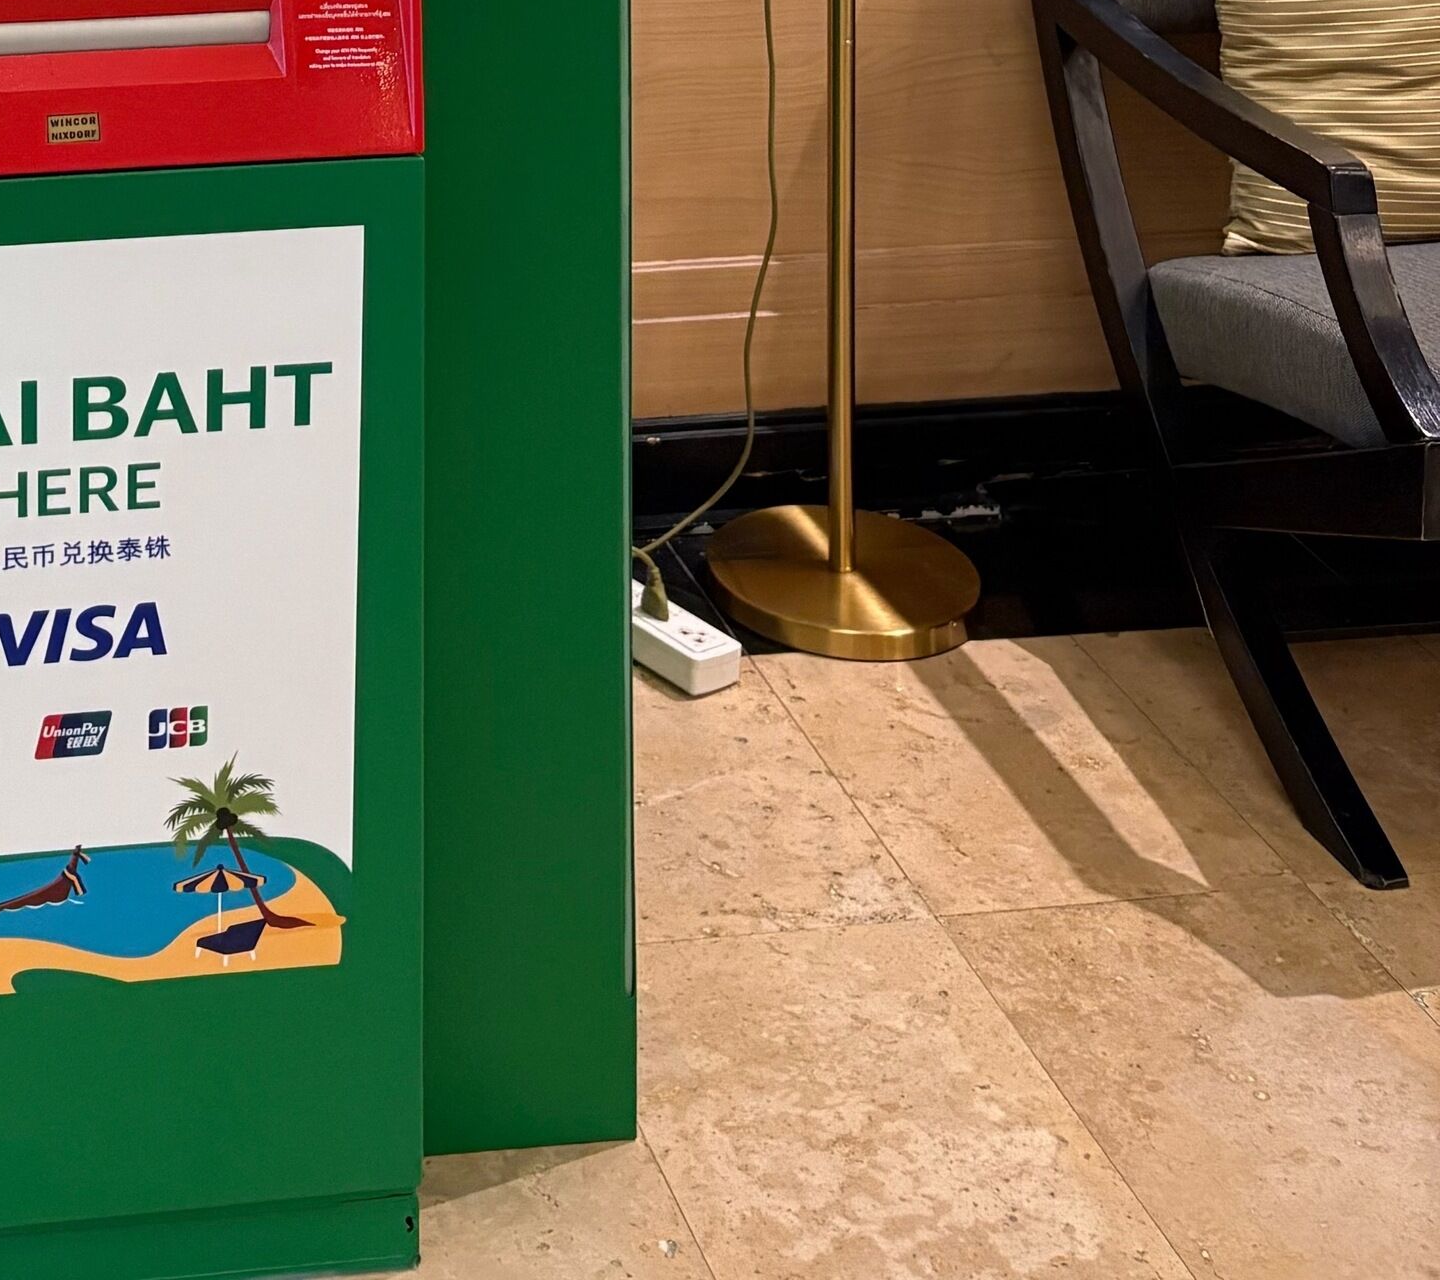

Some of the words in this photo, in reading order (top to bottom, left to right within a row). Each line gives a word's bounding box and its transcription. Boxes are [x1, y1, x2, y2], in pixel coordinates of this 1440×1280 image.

[50, 116, 96, 127] WINCOR
[51, 130, 96, 141] NIXDORF
[72, 361, 333, 442] BAHT
[42, 722, 107, 740] UnionPay
[148, 718, 207, 738] JCB
